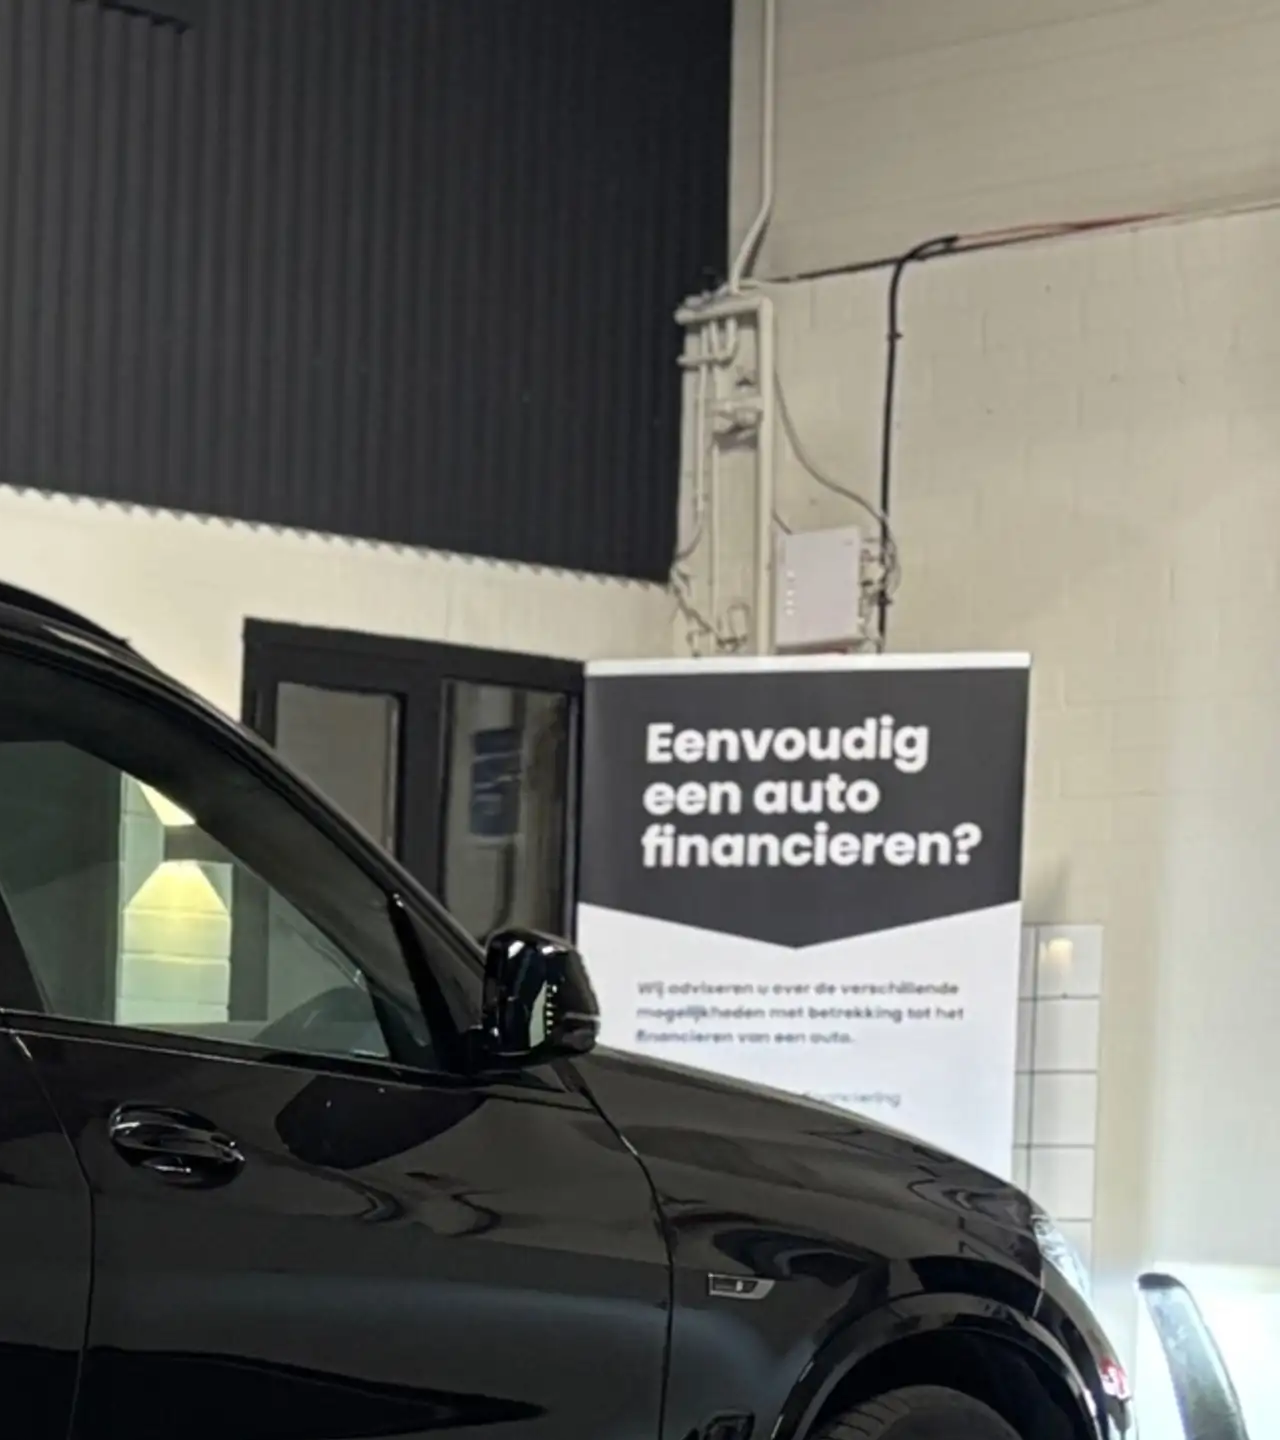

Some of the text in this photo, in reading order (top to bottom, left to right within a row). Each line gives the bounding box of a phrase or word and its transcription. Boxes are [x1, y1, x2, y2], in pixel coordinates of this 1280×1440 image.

[646, 714, 929, 773] Eenvoudig
[643, 773, 881, 815] een auto
[641, 821, 983, 867] financieren?
[638, 981, 959, 999] Wij adviseren u over de verschillende
[636, 1006, 964, 1023] mogelijkheden met betrekking tot het
[635, 1029, 734, 1044] financieren
[738, 1032, 770, 1044] van
[774, 1032, 806, 1044] een
